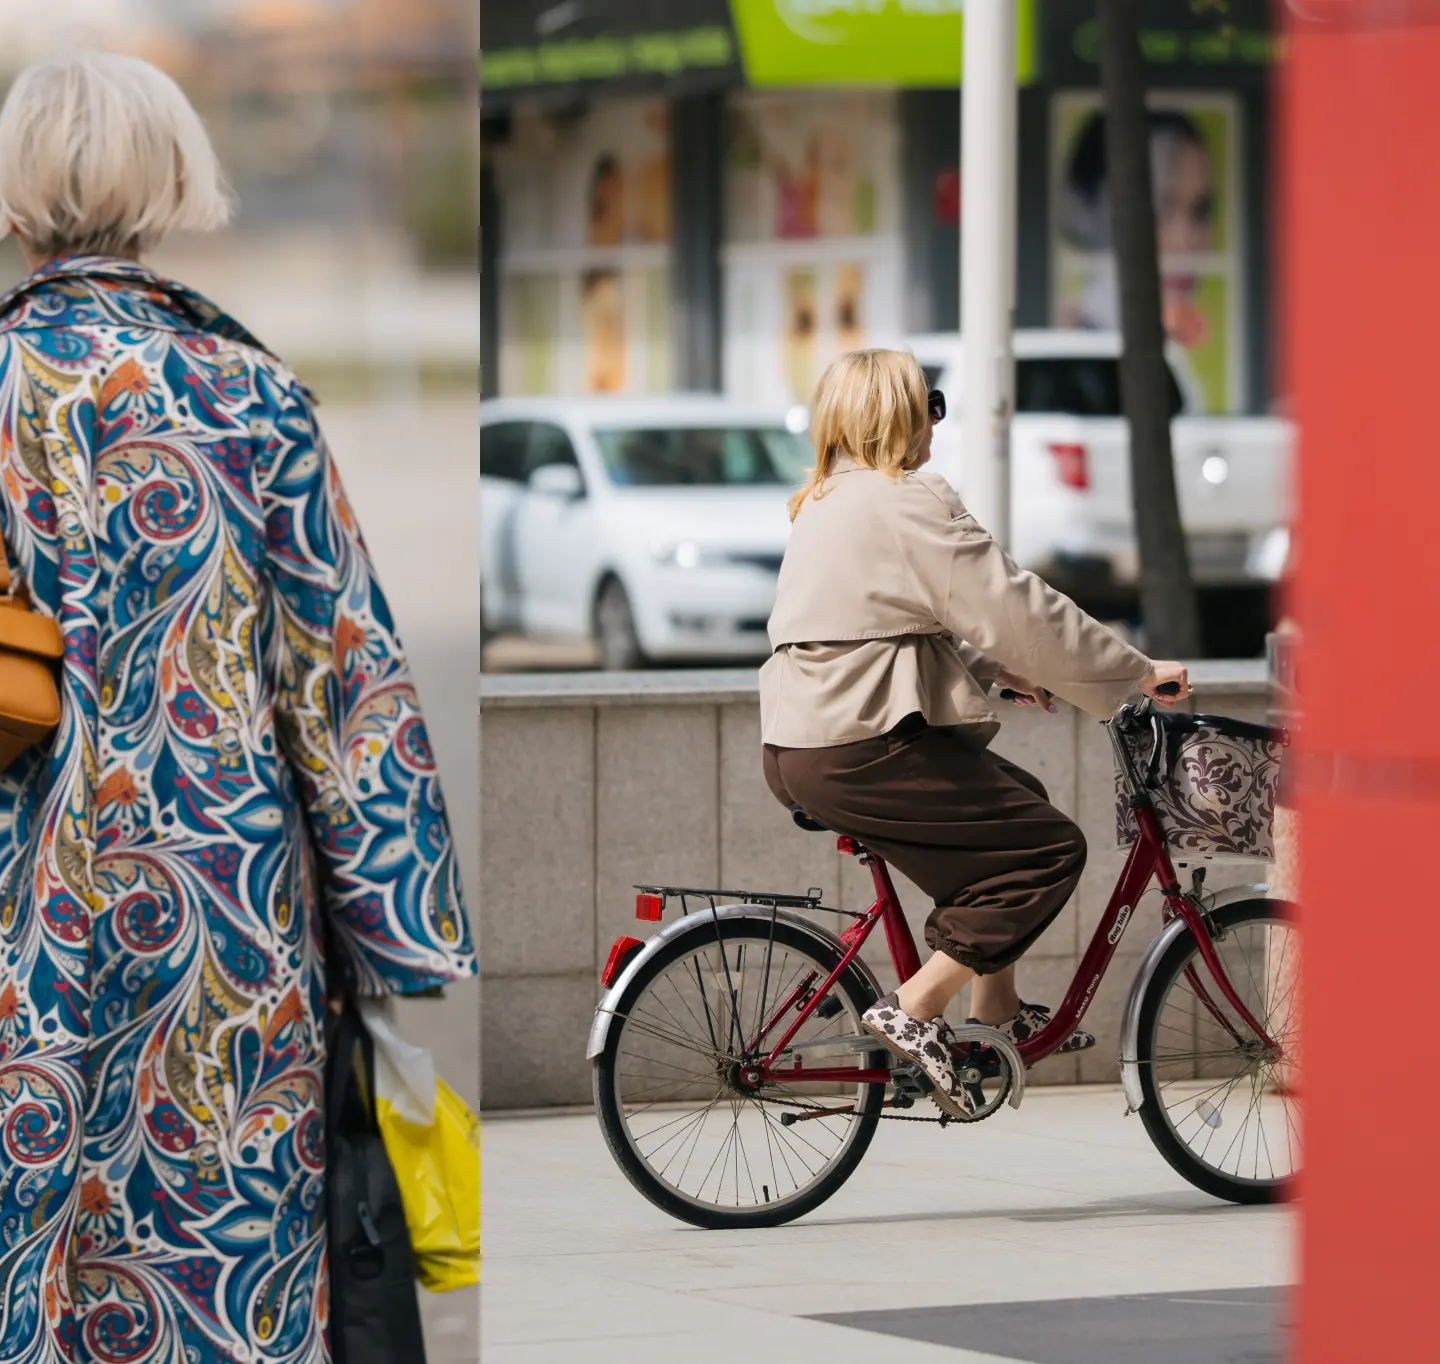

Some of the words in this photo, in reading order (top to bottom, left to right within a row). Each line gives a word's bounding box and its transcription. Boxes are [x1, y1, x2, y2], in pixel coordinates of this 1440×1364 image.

[1110, 925, 1121, 942] Rog
[1117, 906, 1130, 926] bike
[1086, 973, 1100, 995] Pony
